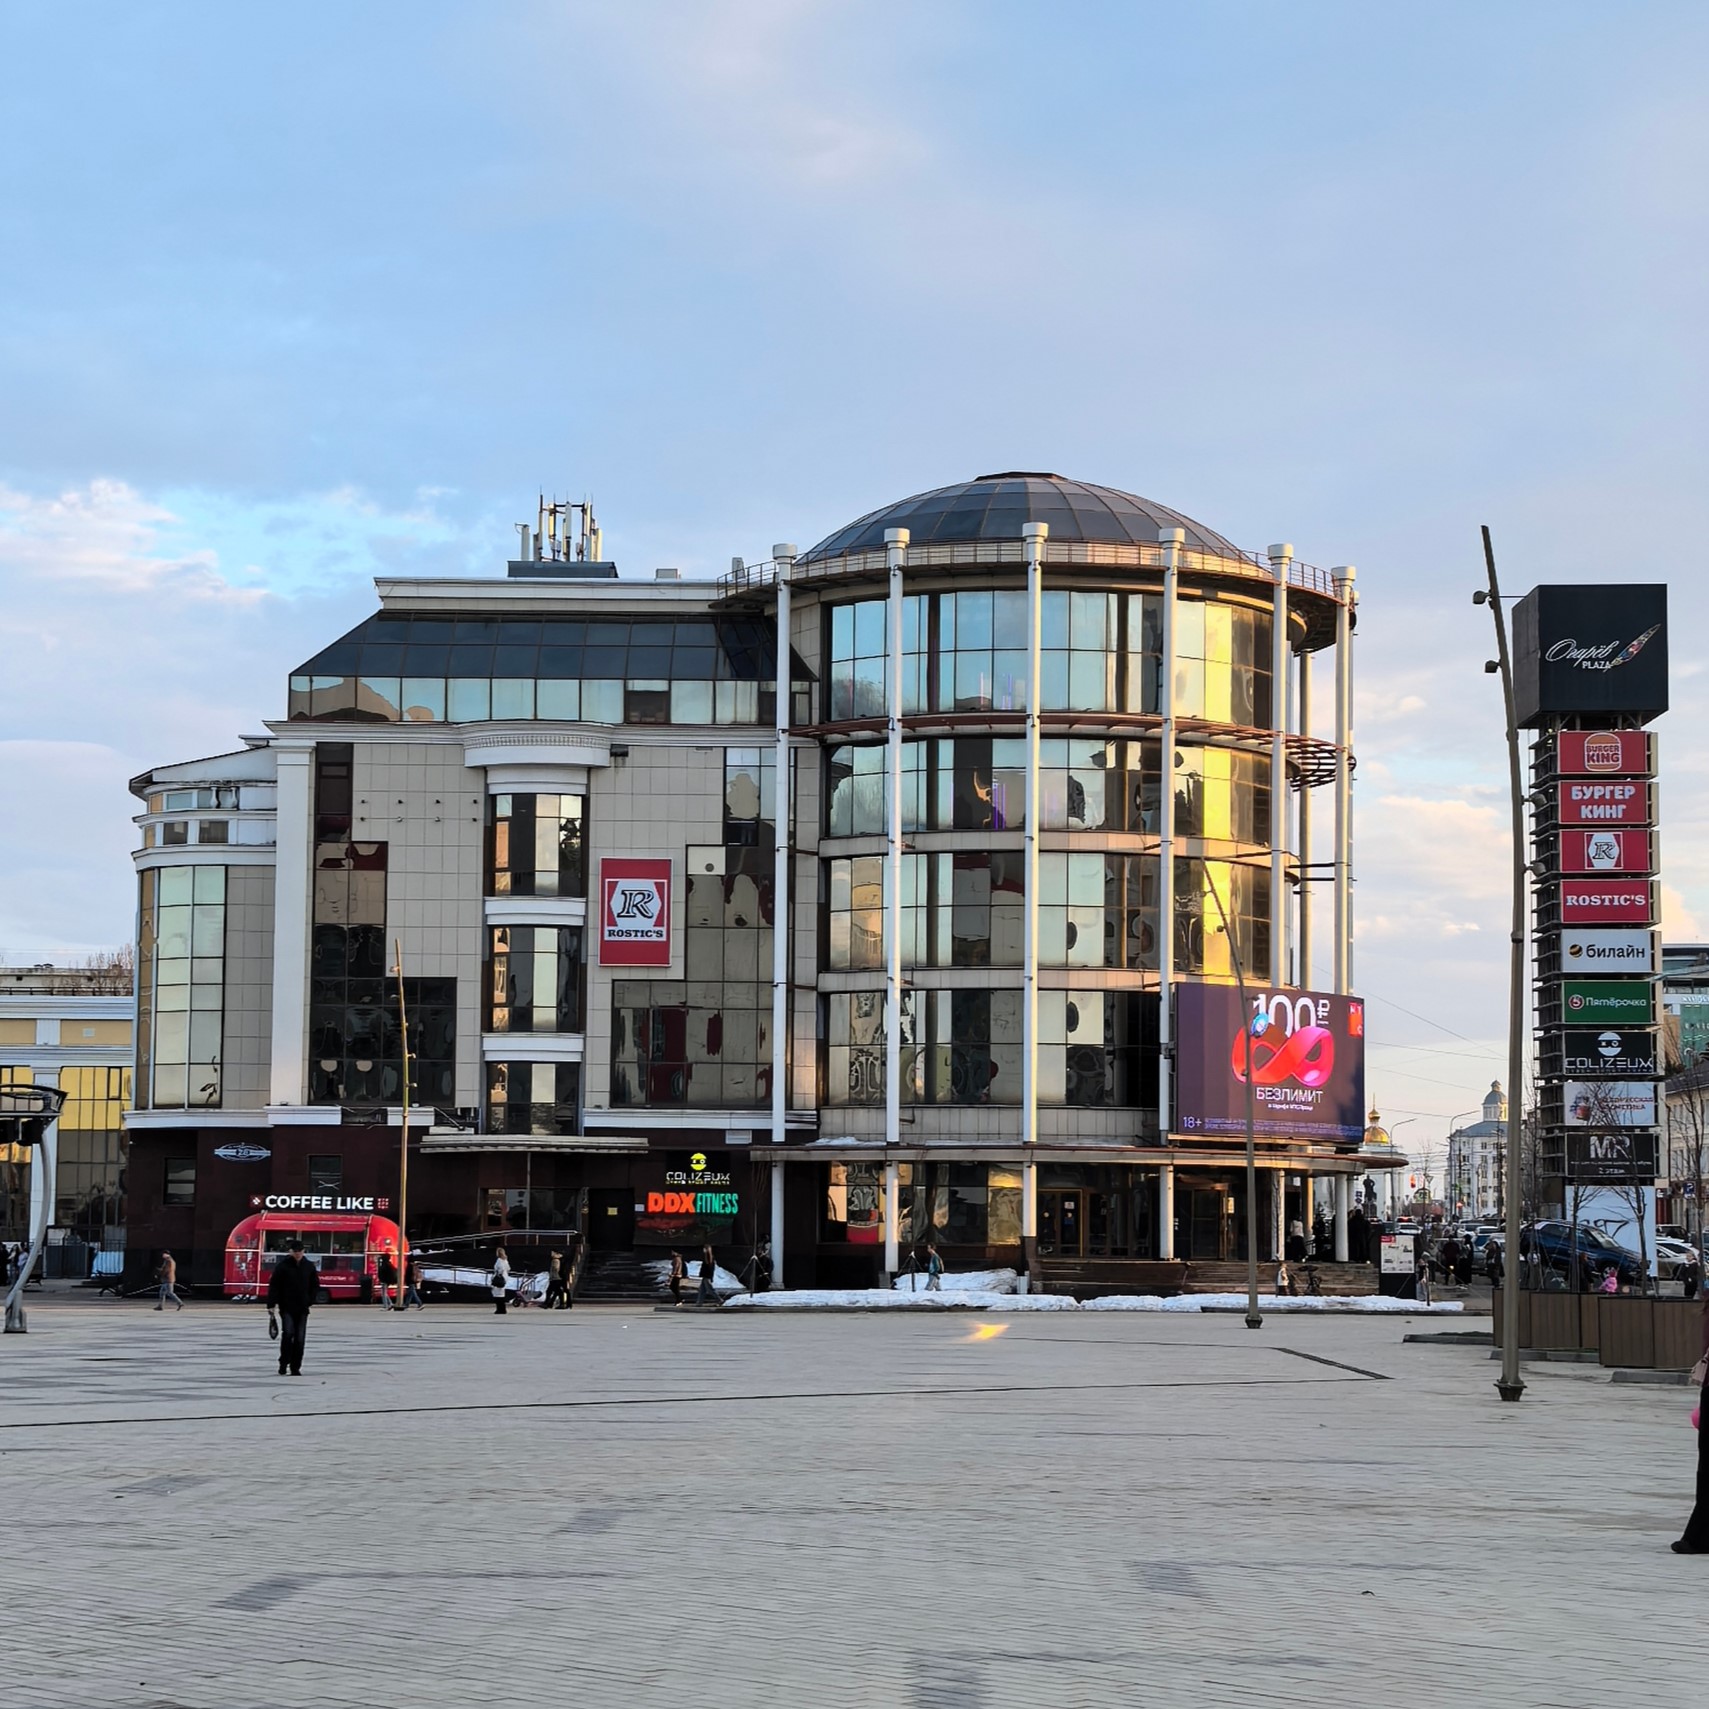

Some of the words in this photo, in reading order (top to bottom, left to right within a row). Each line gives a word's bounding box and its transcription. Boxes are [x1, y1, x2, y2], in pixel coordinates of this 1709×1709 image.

[1545, 638, 1620, 668] Огарёв
[1582, 661, 1611, 669] PLAZA
[1586, 753, 1619, 763] KING
[1571, 785, 1636, 800] БУРГЕР
[1580, 804, 1627, 819] КИНГ
[1566, 894, 1646, 906] ROSTIC'S
[607, 929, 664, 938] ROSTIC'S
[1586, 944, 1645, 958] билайн
[1586, 997, 1647, 1008] Пятёрочка
[1256, 1087, 1324, 1103] БЕЗЛИМИТ
[1183, 1116, 1202, 1129] 18+
[265, 1195, 332, 1210] COFFEE
[336, 1196, 374, 1210] LIKE
[647, 1192, 696, 1213] DDX
[696, 1193, 739, 1214] FITNESS
